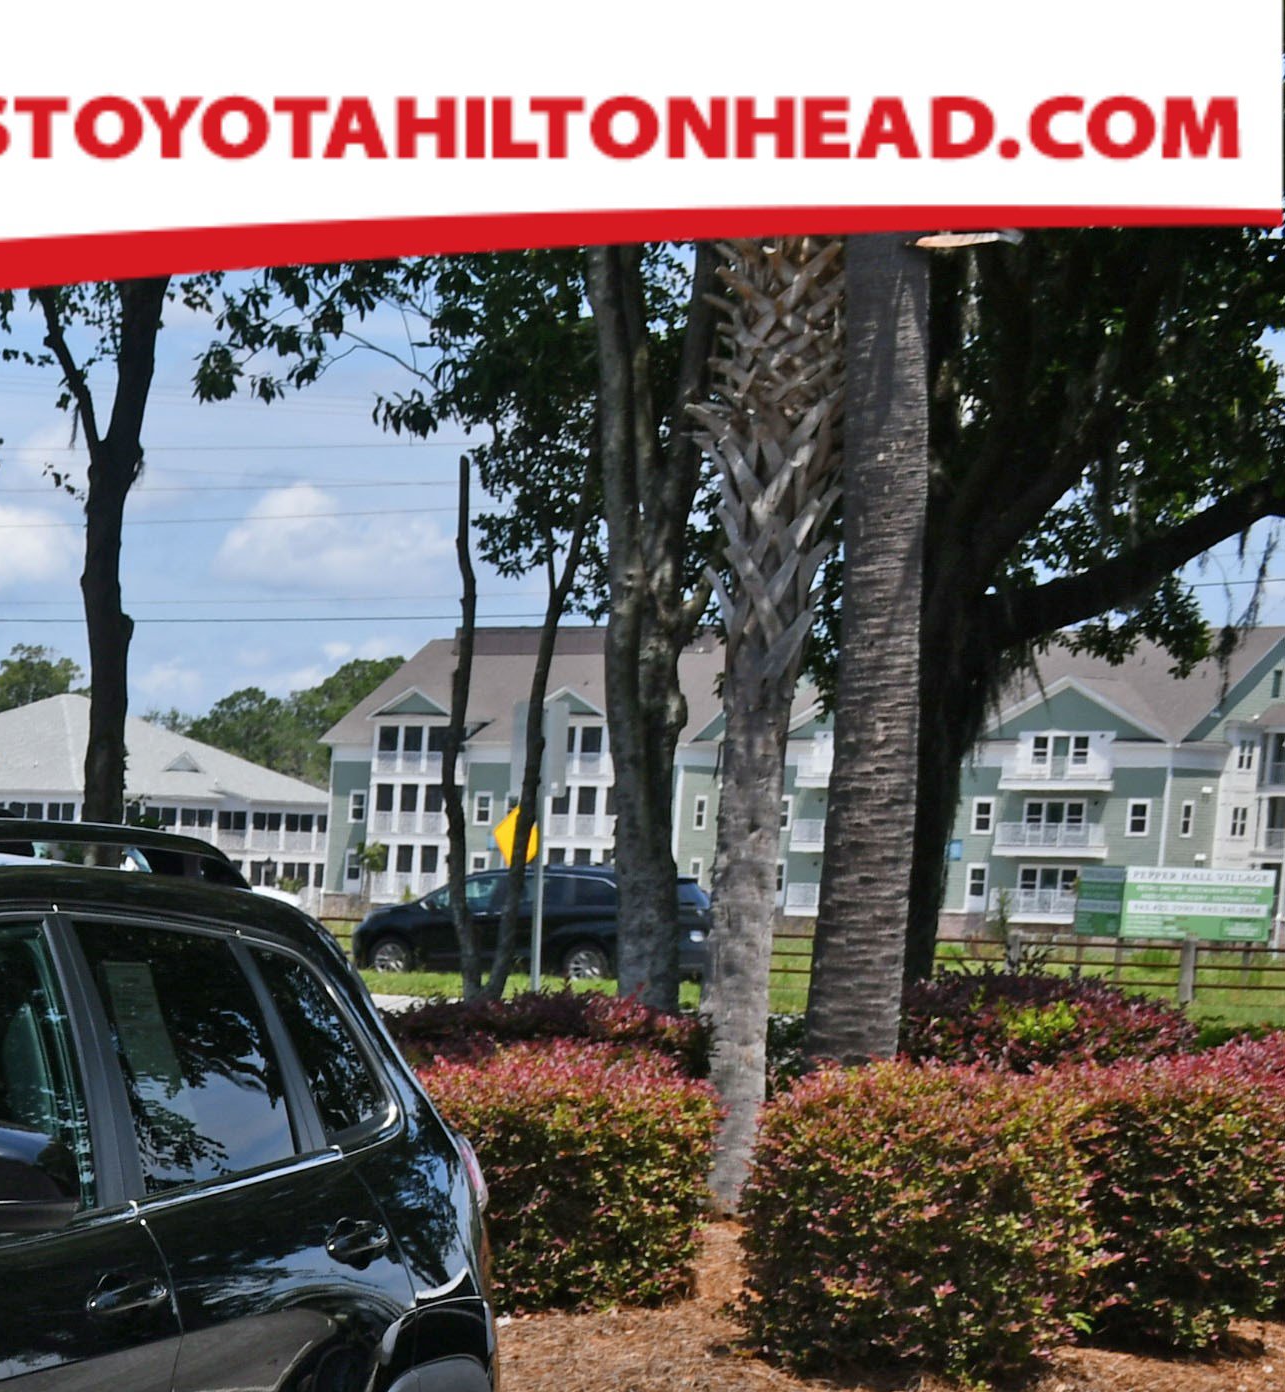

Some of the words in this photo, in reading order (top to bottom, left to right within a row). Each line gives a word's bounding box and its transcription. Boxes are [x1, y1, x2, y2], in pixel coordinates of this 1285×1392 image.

[1133, 871, 1176, 881] PEPPER
[1181, 872, 1211, 881] HALL
[1217, 873, 1269, 882] VILLAGE
